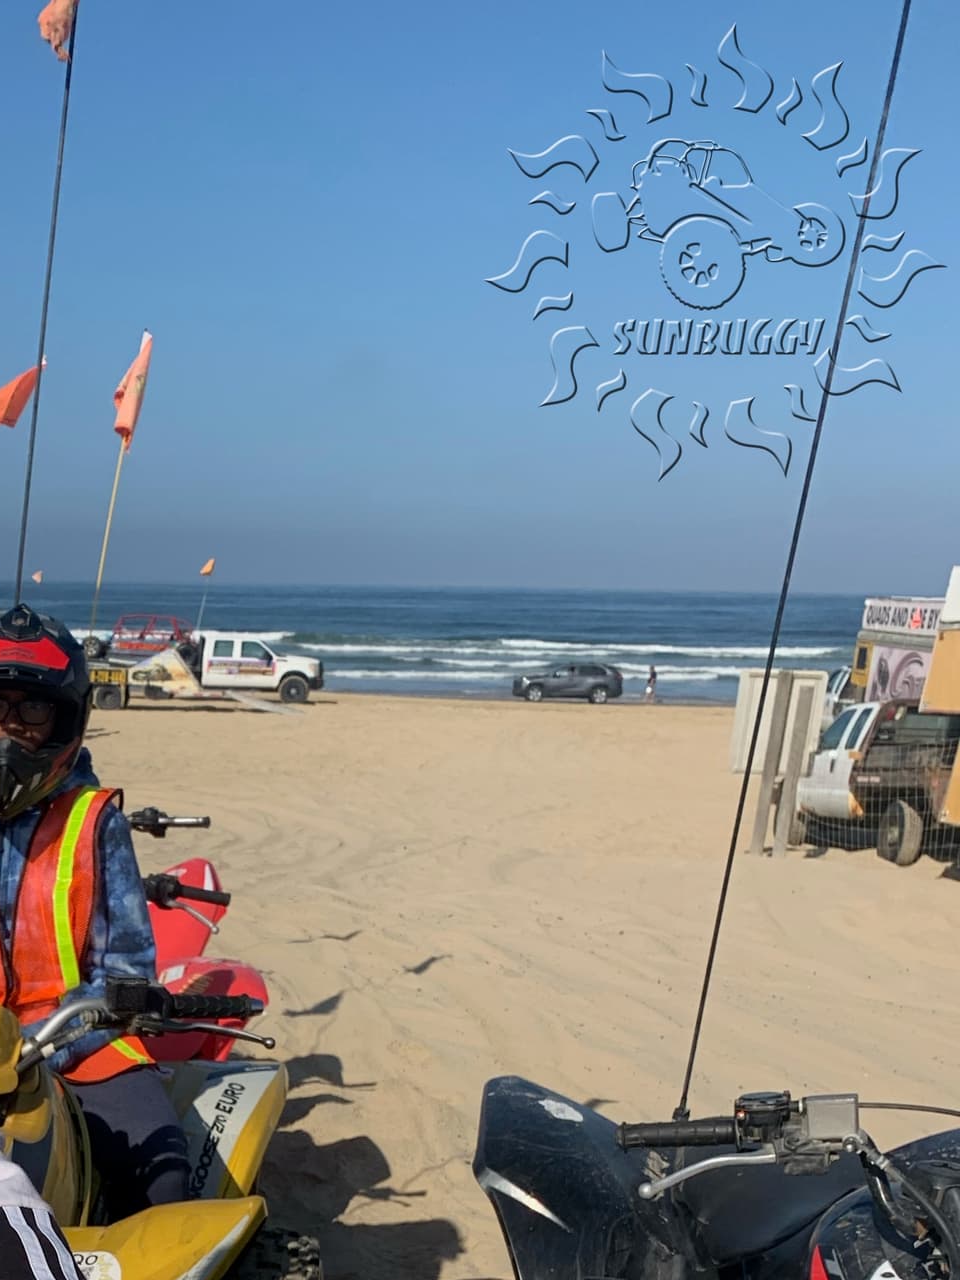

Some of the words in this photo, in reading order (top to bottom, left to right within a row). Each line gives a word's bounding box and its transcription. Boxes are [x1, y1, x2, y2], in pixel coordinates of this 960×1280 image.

[866, 605, 891, 625] QUADS
[890, 606, 909, 628] AND
[926, 608, 941, 630] BY
[214, 1082, 246, 1115] EURO
